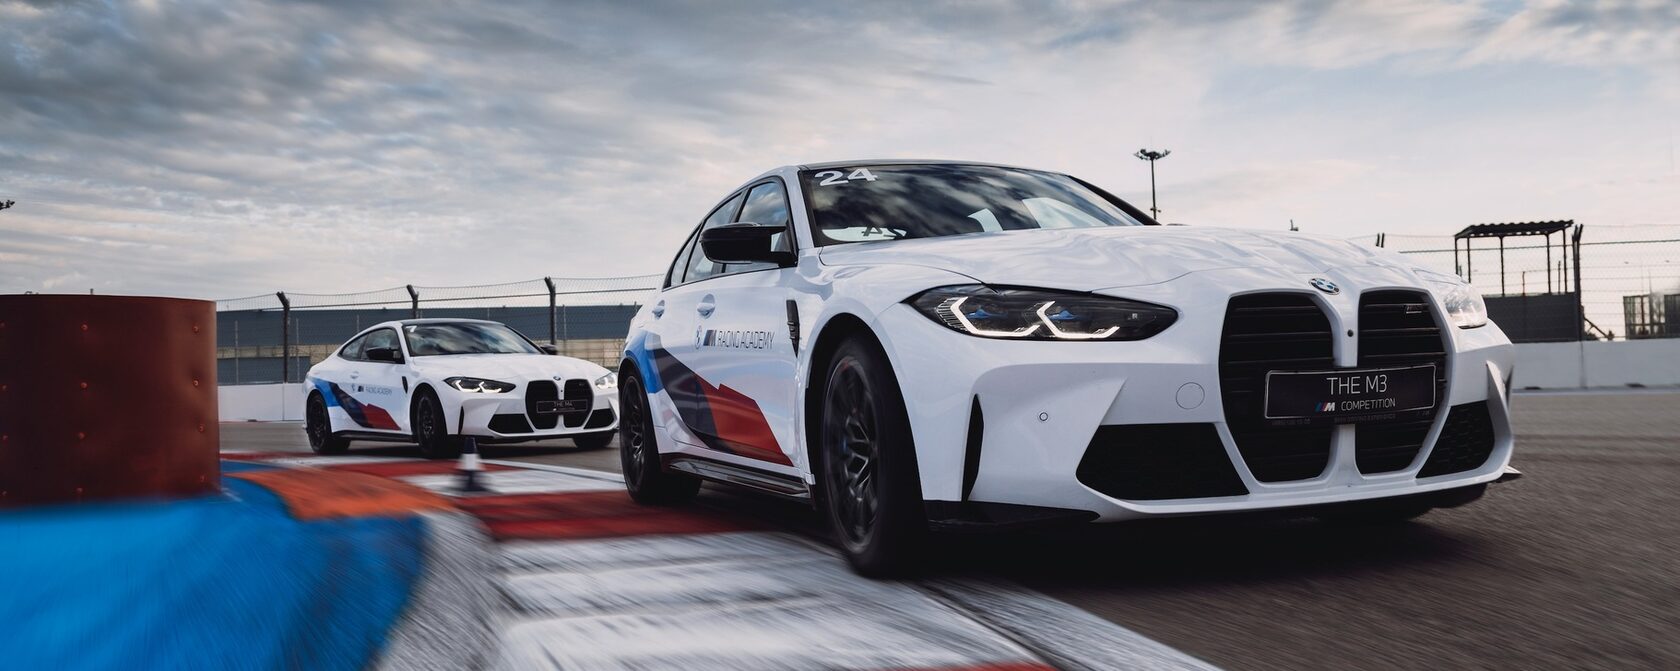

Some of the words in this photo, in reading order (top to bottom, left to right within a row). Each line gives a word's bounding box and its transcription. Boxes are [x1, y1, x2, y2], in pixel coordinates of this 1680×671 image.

[814, 168, 878, 187] 24
[718, 330, 740, 347] RACING
[741, 331, 775, 349] ACADEMY
[1327, 377, 1360, 395] THE
[1366, 374, 1387, 393] M3
[1341, 398, 1396, 411] COMPETITION
